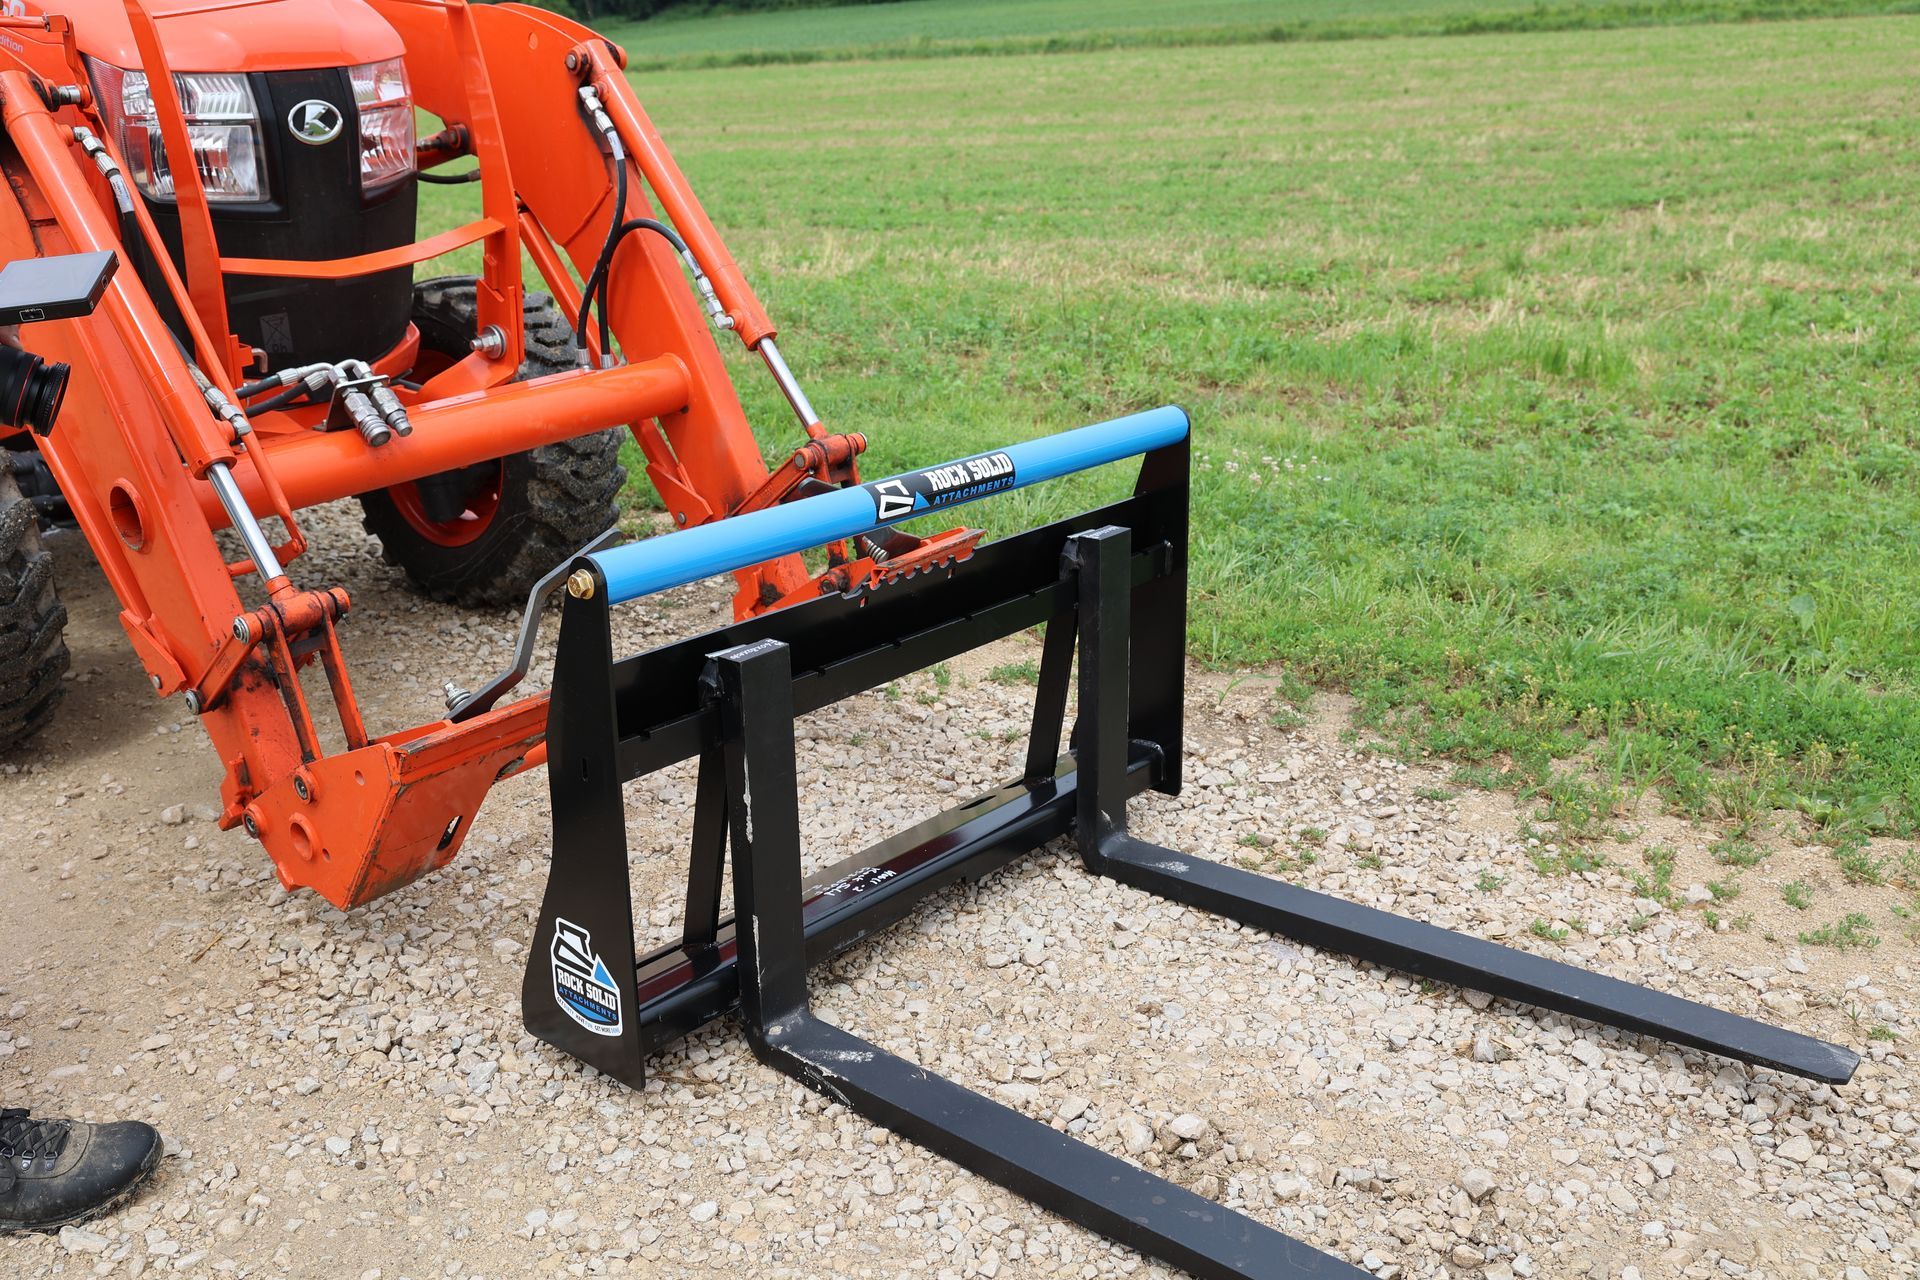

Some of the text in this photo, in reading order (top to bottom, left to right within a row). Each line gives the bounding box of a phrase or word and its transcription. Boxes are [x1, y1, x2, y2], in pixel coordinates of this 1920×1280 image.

[923, 453, 1014, 492] ROCK SOLID
[933, 476, 1014, 506] ATTACHMENTS
[556, 968, 617, 1011] ROCK SOLID
[558, 986, 617, 1021] ATTACHMENTS
